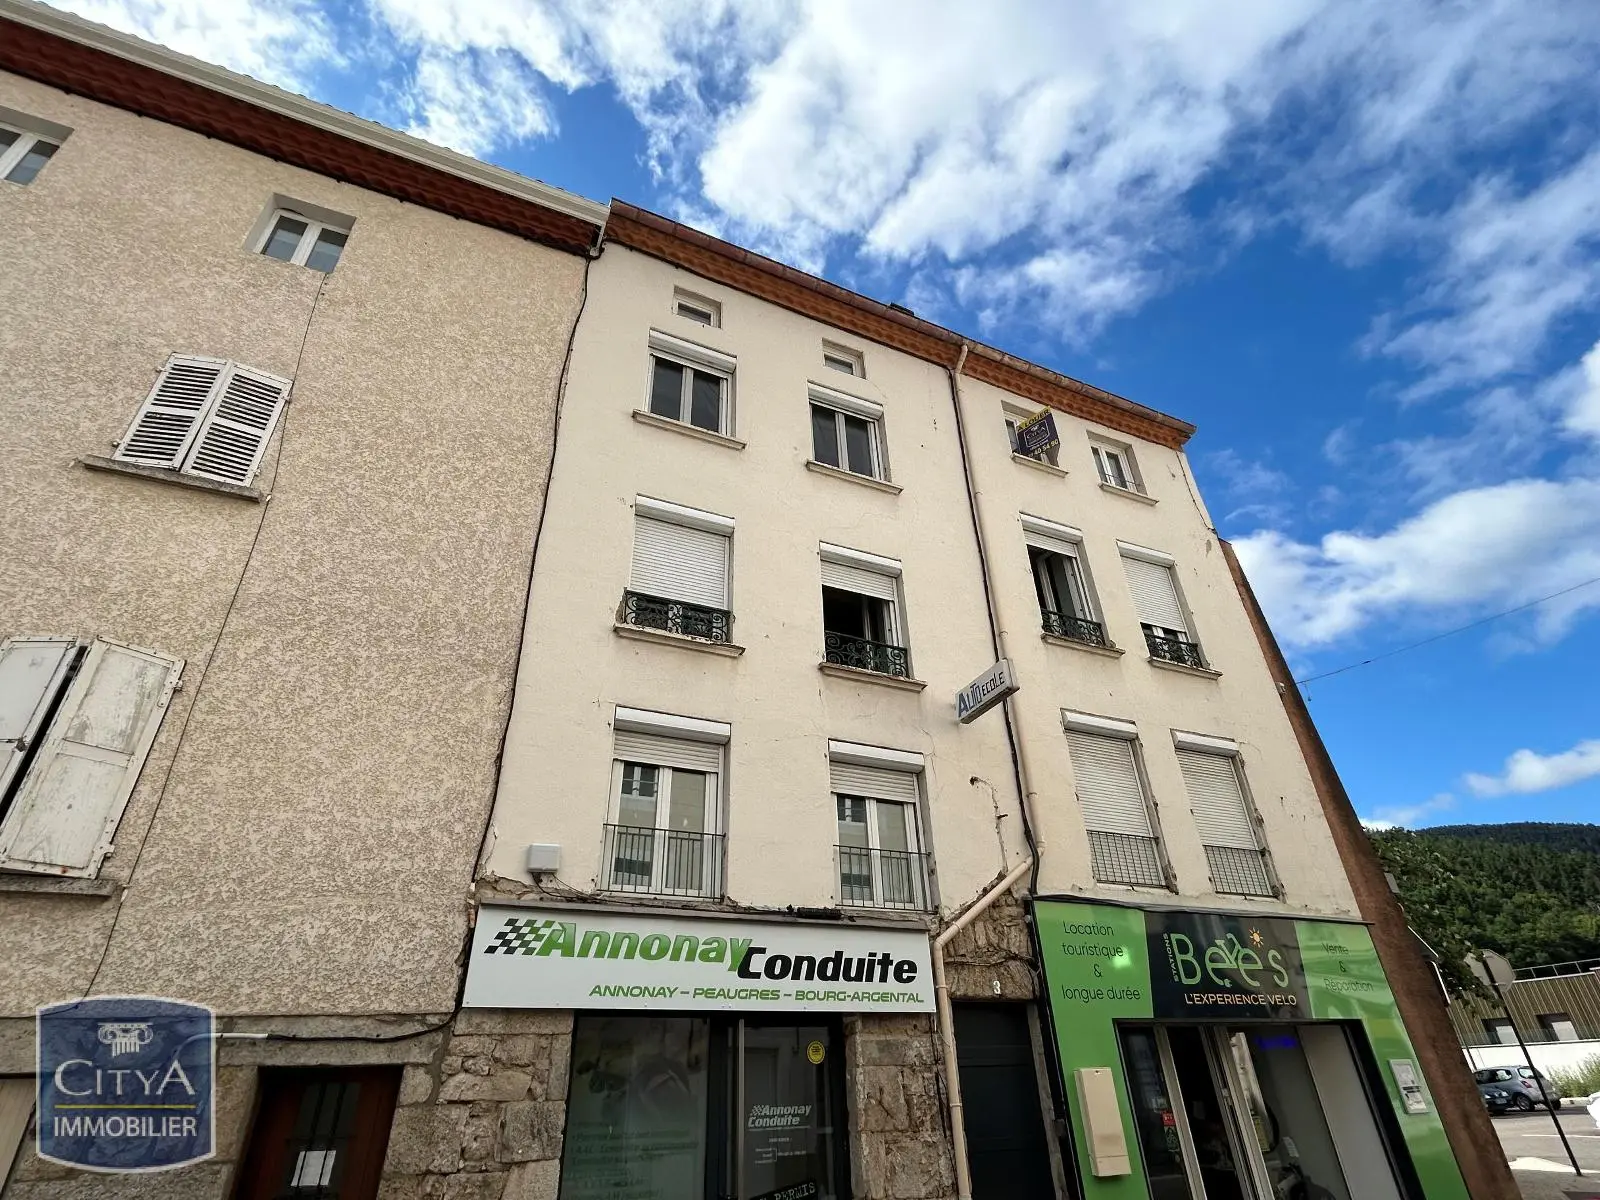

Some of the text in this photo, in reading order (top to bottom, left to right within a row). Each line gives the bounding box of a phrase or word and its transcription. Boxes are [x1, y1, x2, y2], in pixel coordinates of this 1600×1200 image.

[1063, 920, 1115, 936] Location
[533, 921, 752, 972] Annonay
[1062, 942, 1124, 960] touristique
[1321, 942, 1349, 954] Vente
[737, 946, 918, 984] Conduite
[1162, 932, 1180, 982] STATIONS
[1093, 963, 1103, 978] &
[588, 984, 679, 998] ANNONAY
[692, 987, 781, 1000] PEAUGRES
[795, 990, 924, 1003] BOURG-ARGENTAL
[993, 980, 1001, 995] 3
[1061, 984, 1141, 1003] longue durée
[1184, 993, 1297, 1006] L'EXPERIENCE VELO
[760, 1104, 812, 1116] Annonay
[747, 1114, 800, 1128] Conduite
